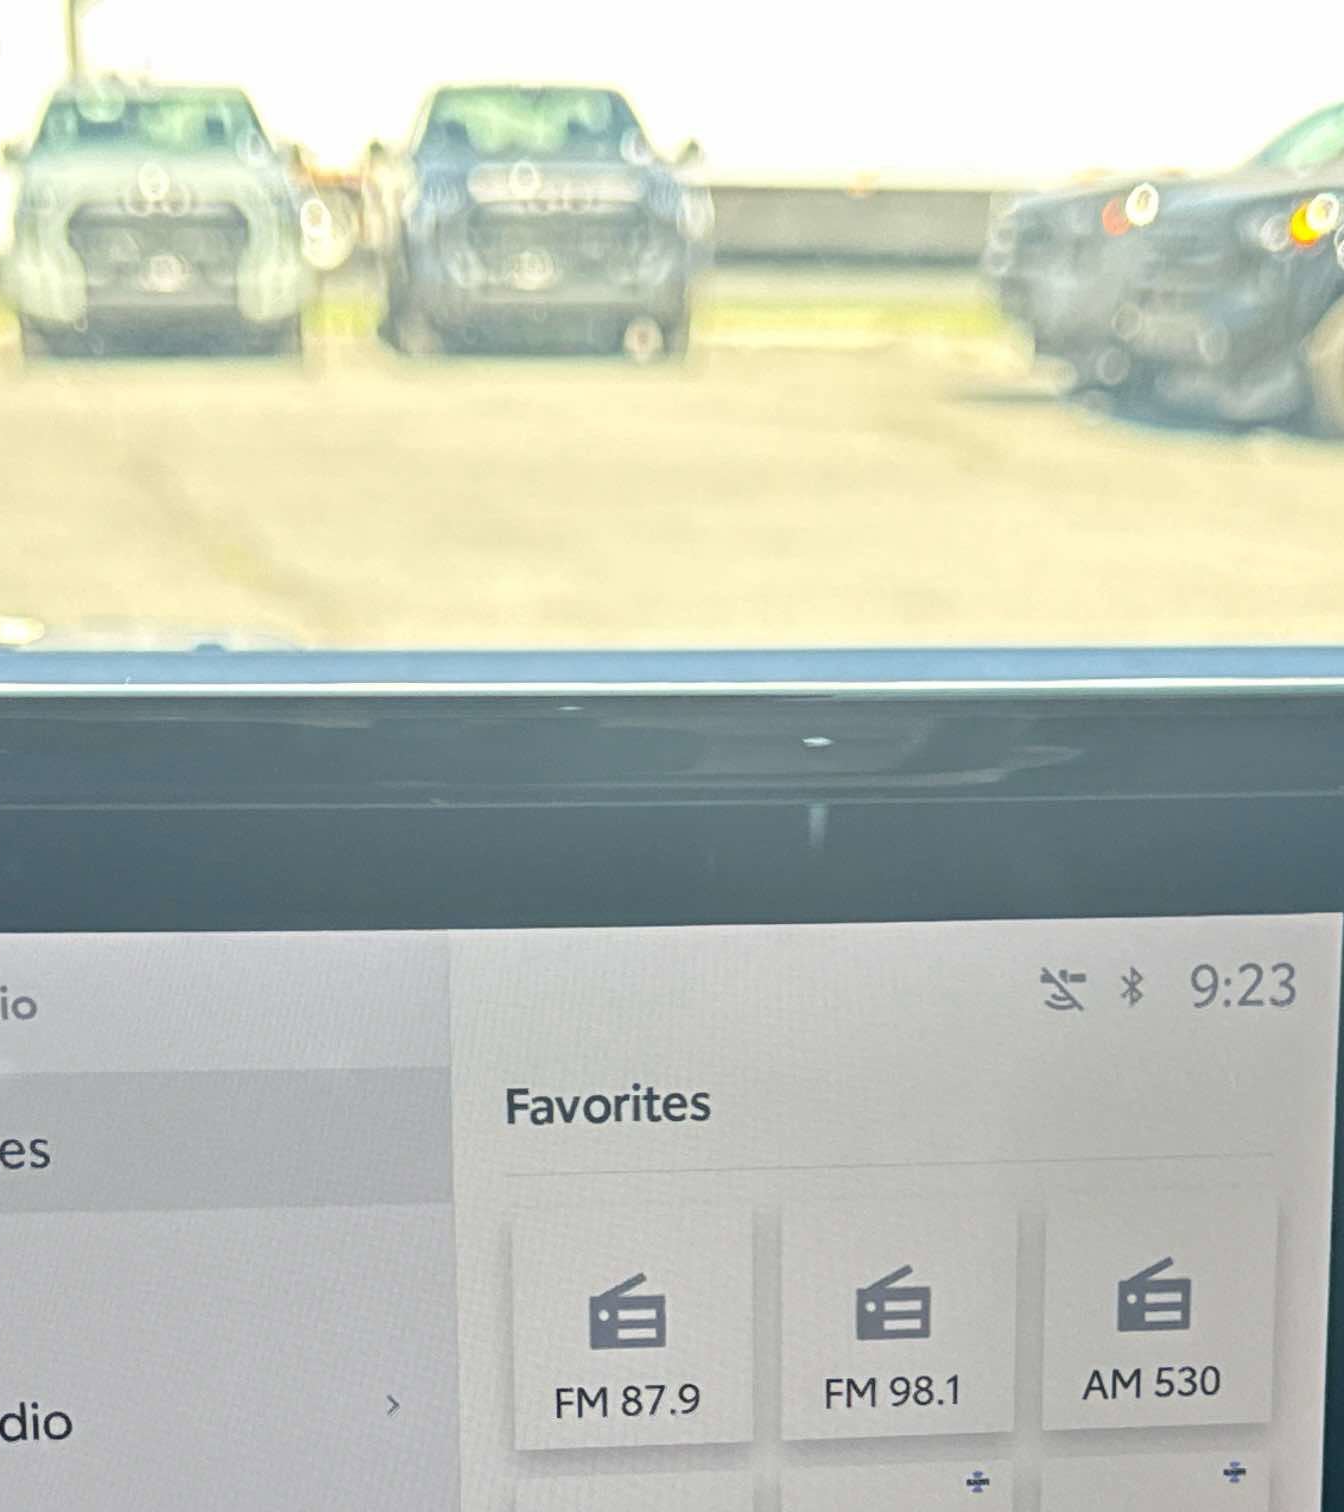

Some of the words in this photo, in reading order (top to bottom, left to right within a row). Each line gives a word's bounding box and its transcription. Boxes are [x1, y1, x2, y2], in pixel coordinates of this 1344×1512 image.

[1191, 963, 1296, 1008] 9:23
[507, 1083, 710, 1125] Favorites
[826, 1378, 876, 1409] FM
[890, 1375, 958, 1406] 98.1
[1083, 1368, 1141, 1400] AM
[1155, 1366, 1220, 1397] 530
[556, 1387, 607, 1418] FM
[622, 1384, 700, 1416] 87.9
